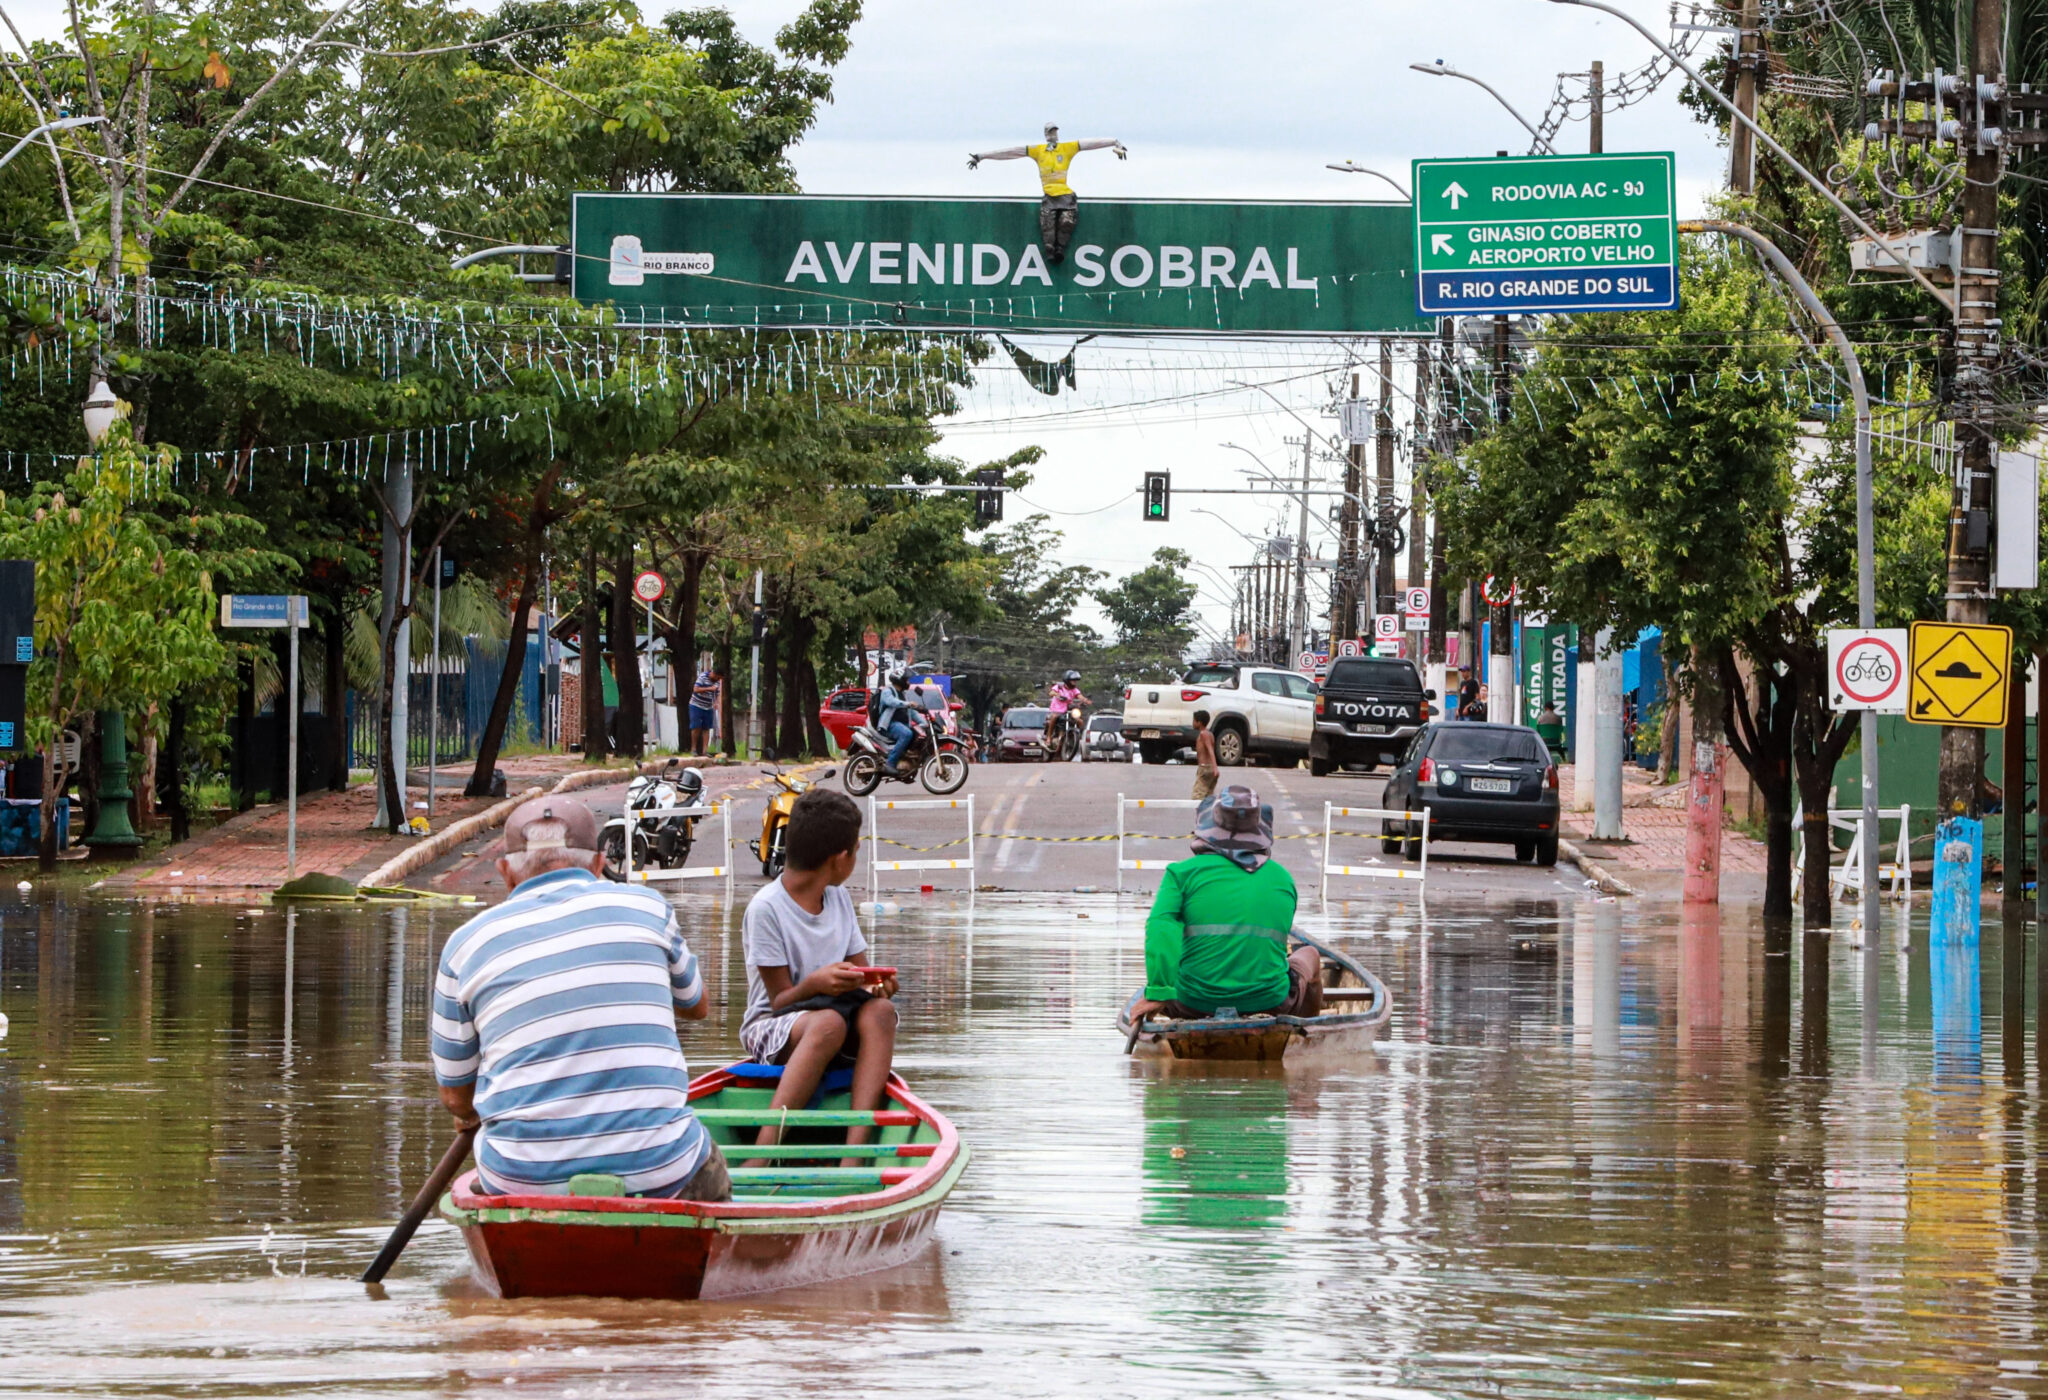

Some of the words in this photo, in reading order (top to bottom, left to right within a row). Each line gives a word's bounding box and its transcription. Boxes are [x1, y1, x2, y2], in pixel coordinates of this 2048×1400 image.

[1491, 183, 1578, 202] RODOVIA
[1580, 181, 1607, 198] AC
[1468, 225, 1546, 243] GINASIO
[1550, 223, 1642, 241] COBERTO
[784, 240, 1053, 286] AVENIDA
[1073, 244, 1319, 289] SOBRAL
[1468, 246, 1587, 265] AEROPORTO
[1590, 244, 1655, 261] VELHO
[643, 261, 662, 270] RIO
[665, 261, 710, 270] BRANCO
[1438, 282, 1458, 299] R.
[1462, 281, 1495, 298] RIO
[1499, 279, 1580, 297] GRANDE
[1584, 278, 1612, 295] DO
[1616, 277, 1654, 294] SUL
[1413, 593, 1423, 607] E
[1382, 620, 1391, 632] E
[1304, 656, 1310, 665] E
[1345, 645, 1352, 656] E
[1527, 661, 1543, 719] SAÍDA
[1552, 633, 1567, 727] NTRADA
[1332, 702, 1410, 719] TOYOTA
